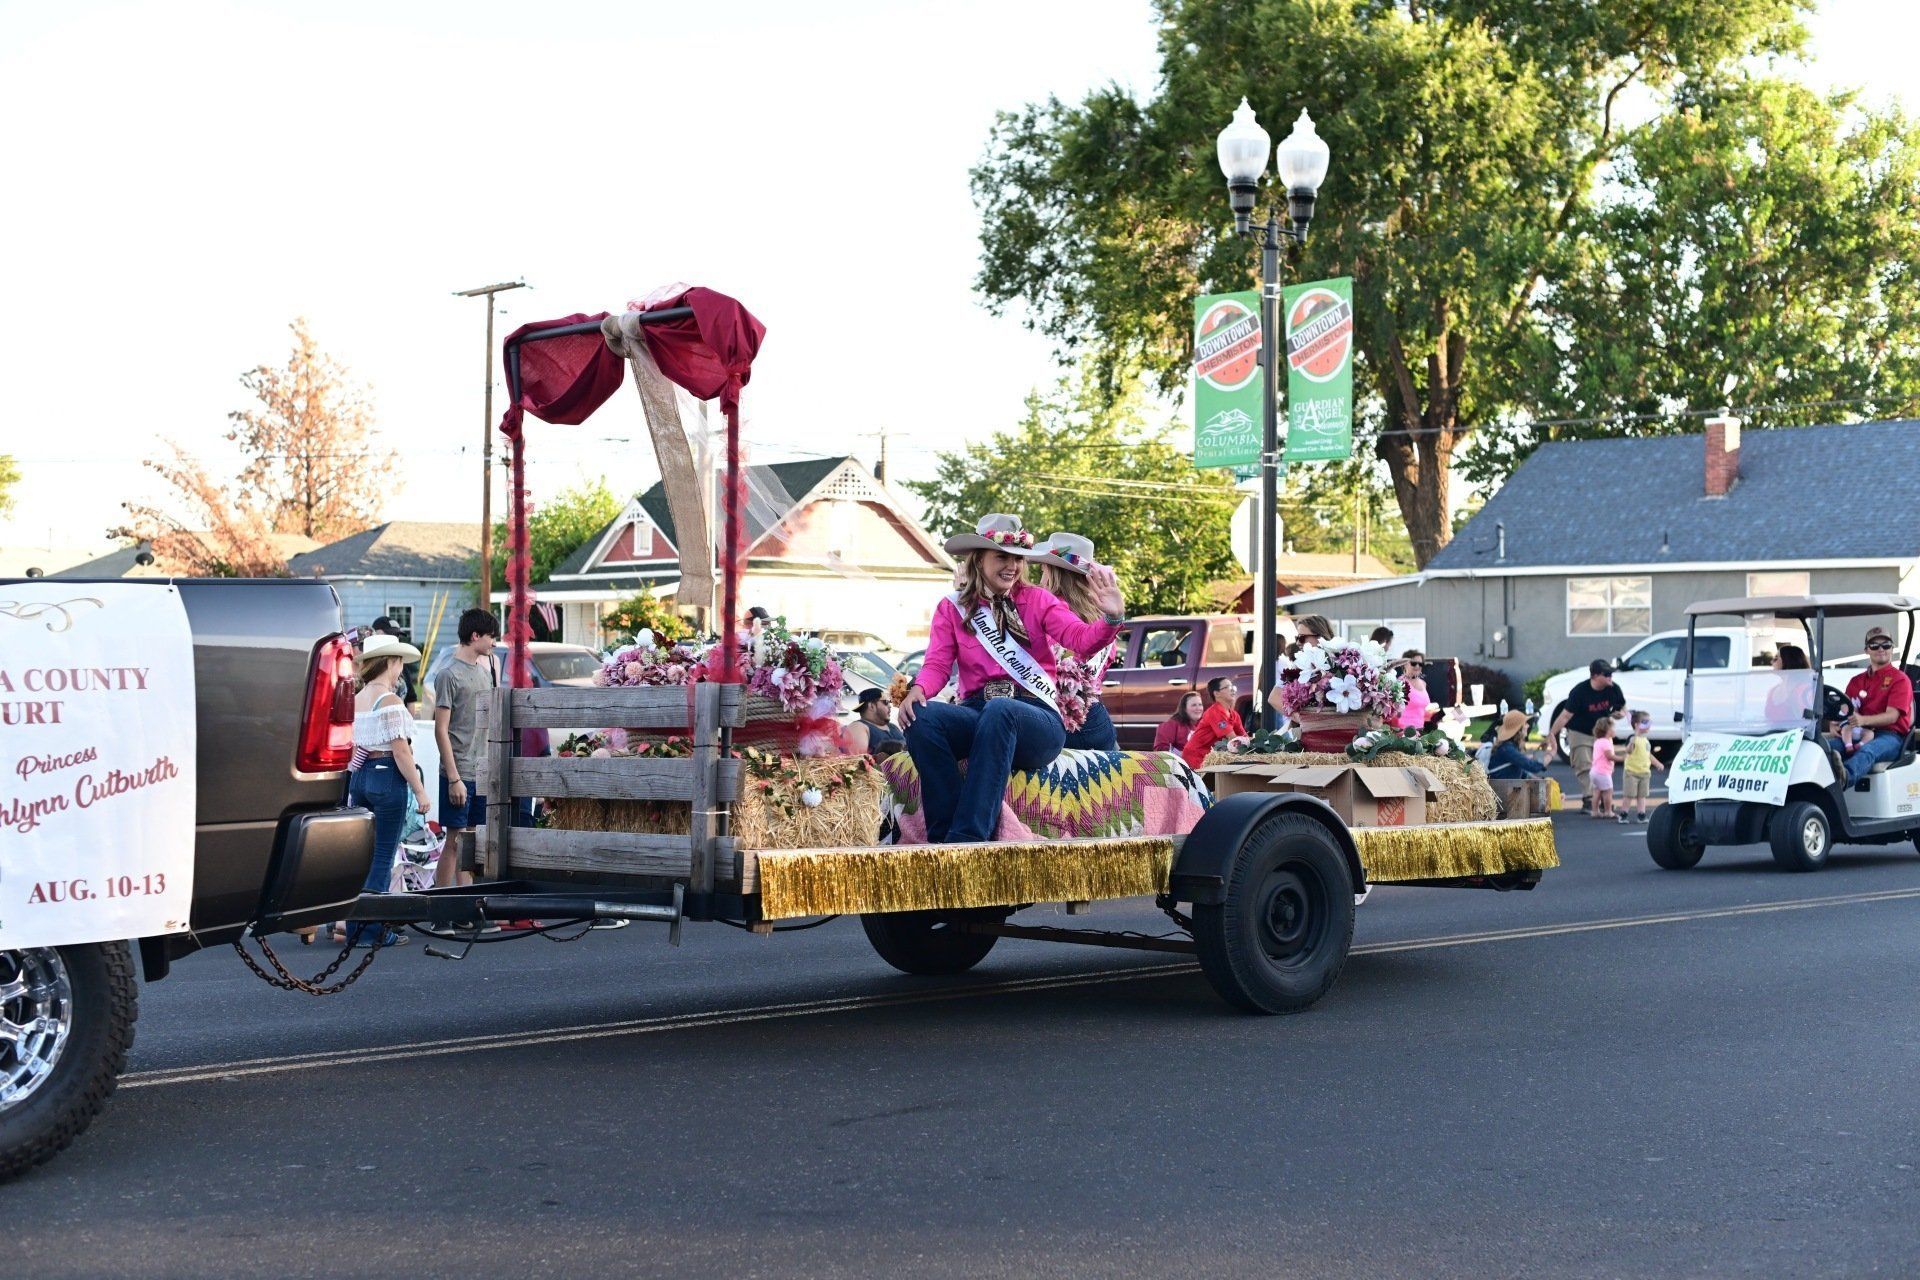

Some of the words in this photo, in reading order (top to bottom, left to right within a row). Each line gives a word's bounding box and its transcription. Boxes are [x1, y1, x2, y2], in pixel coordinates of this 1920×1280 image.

[1199, 319, 1252, 358] DOWNTOWN
[1292, 308, 1343, 349] DOWNTOWN
[1297, 324, 1348, 362] HERMISTON
[1202, 336, 1257, 372] HERMISTON
[1294, 396, 1345, 412] GUARDIAN
[1197, 433, 1261, 448] COLUMBIA
[23, 667, 149, 692] COUNTY
[1003, 650, 1032, 680] County
[1030, 674, 1052, 695] Fair
[1728, 738, 1776, 752] BOARD
[1776, 733, 1796, 752] OF
[16, 746, 98, 782] Princess
[1713, 755, 1792, 775] DIRECTORS
[75, 755, 178, 808] Cutburth
[1683, 775, 1712, 792] Andy
[1718, 774, 1769, 792] Wagner
[28, 880, 96, 904] AUG.
[106, 873, 166, 898] 10-13
